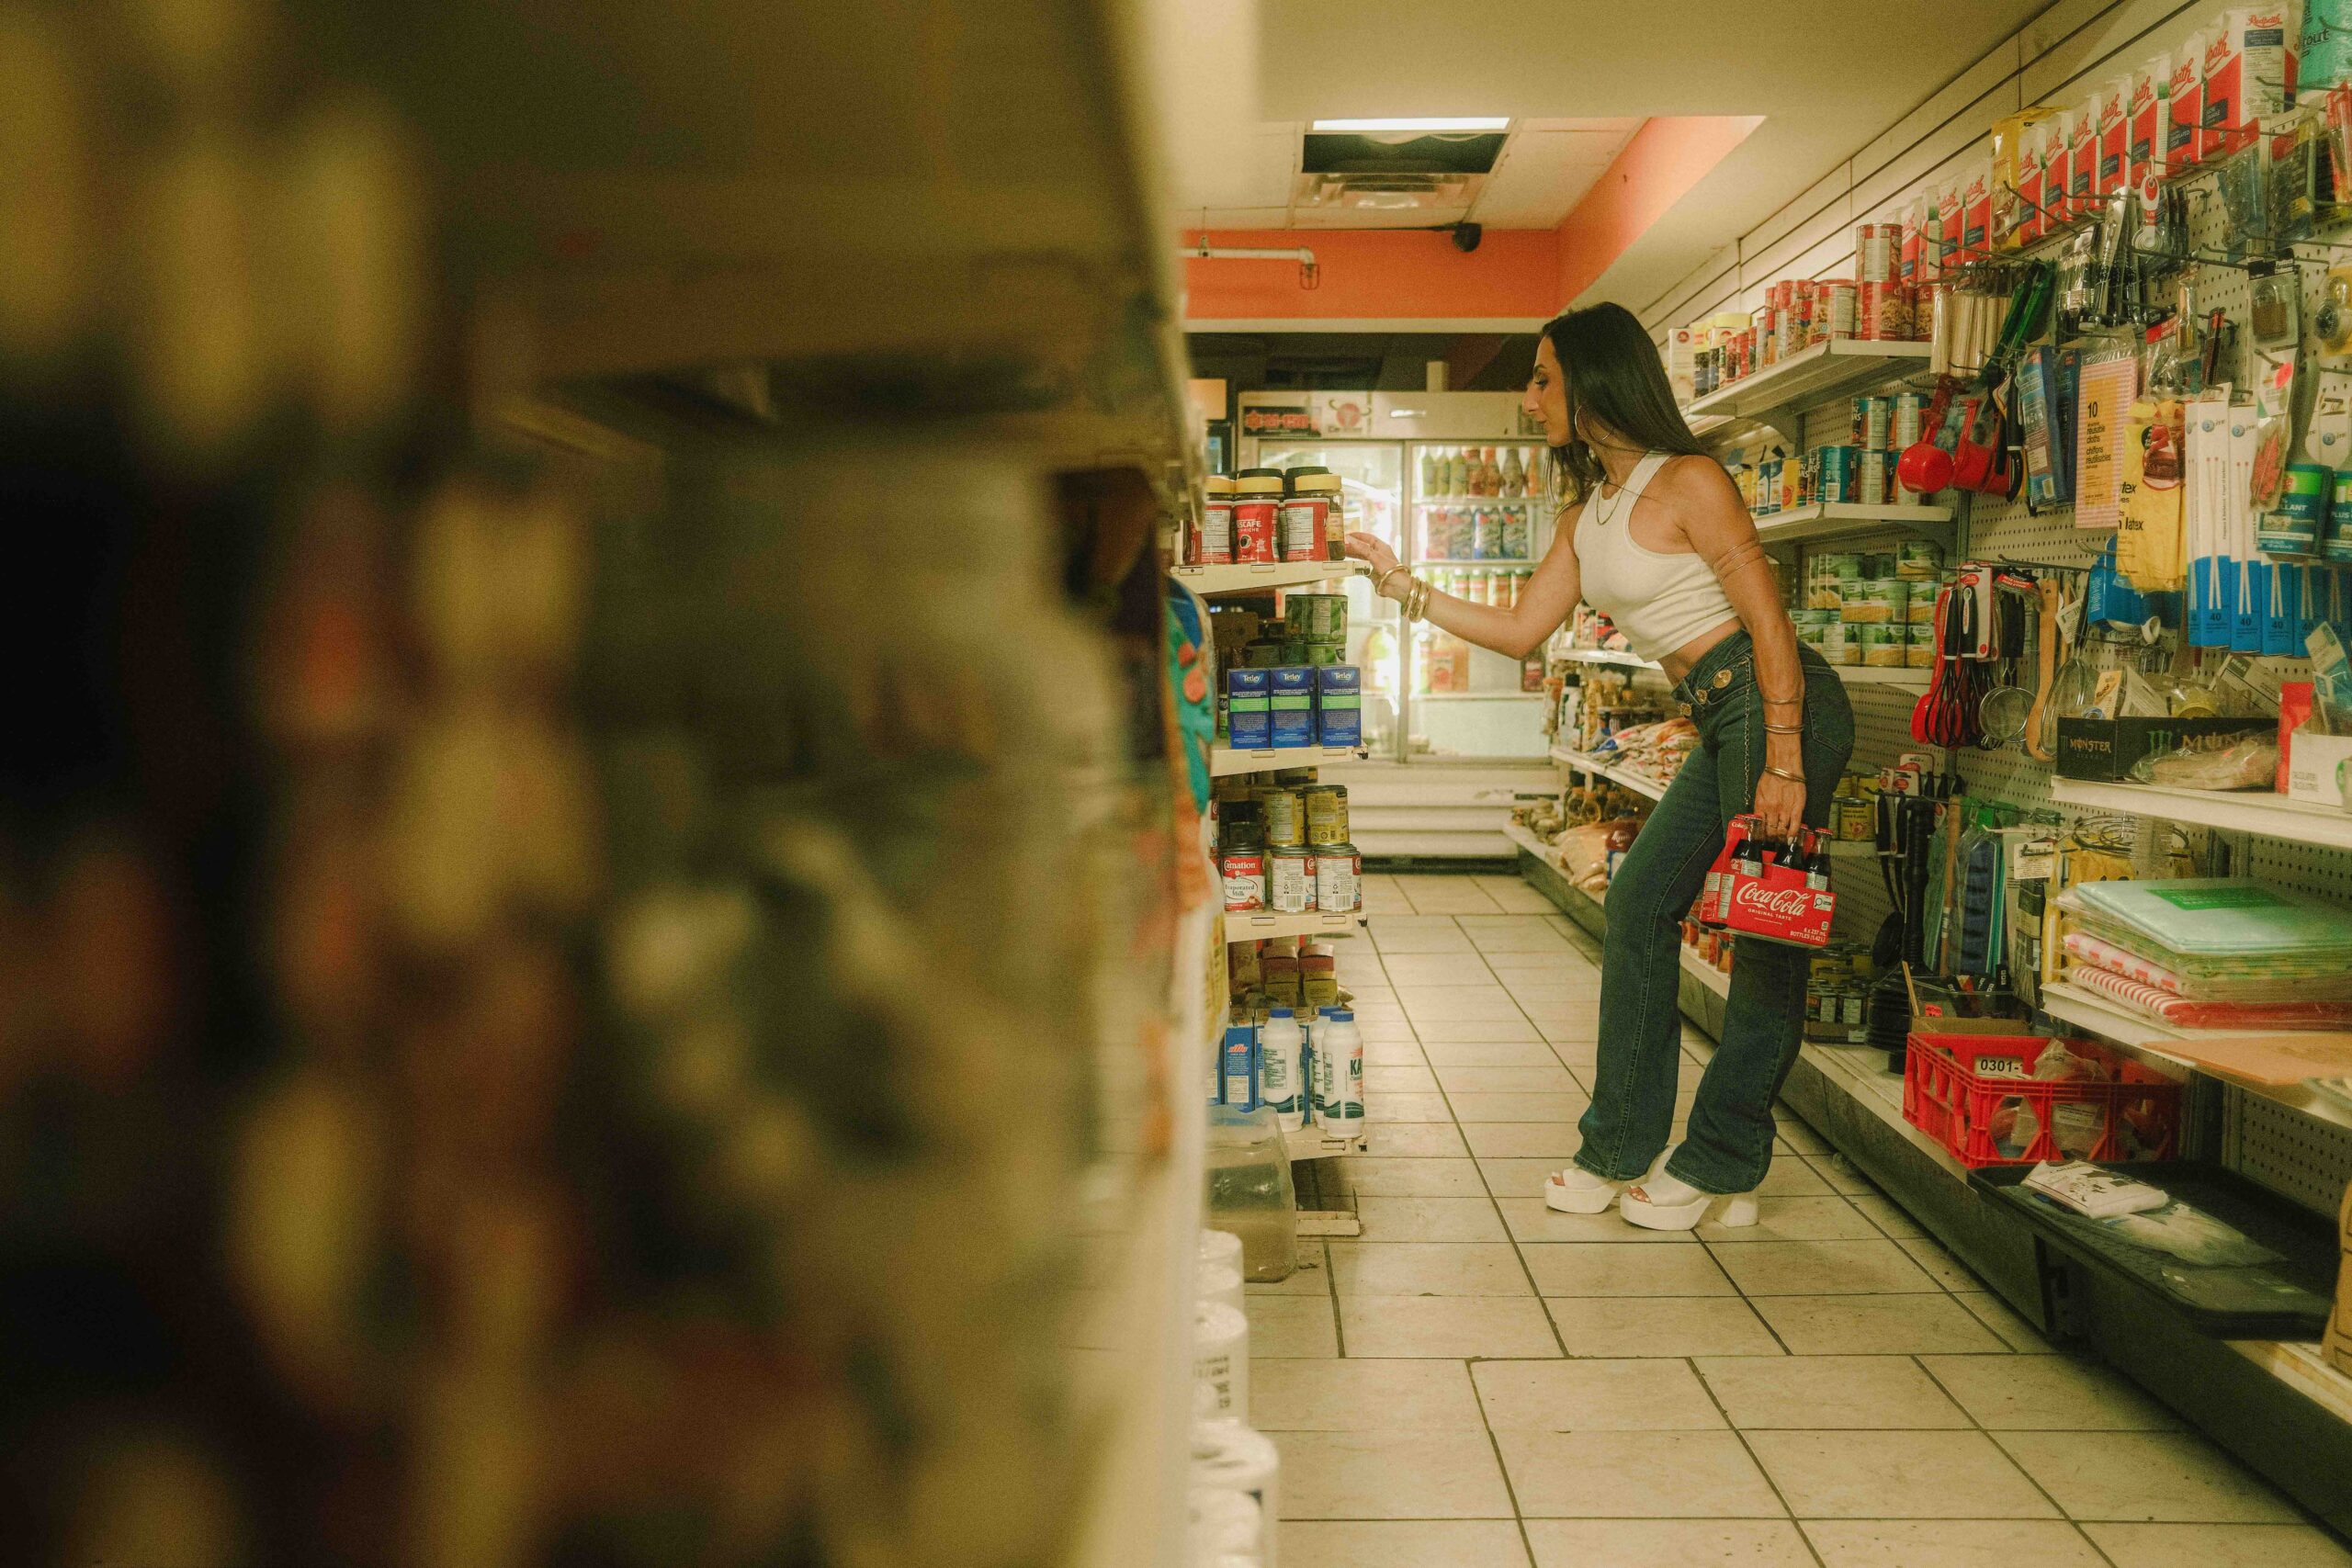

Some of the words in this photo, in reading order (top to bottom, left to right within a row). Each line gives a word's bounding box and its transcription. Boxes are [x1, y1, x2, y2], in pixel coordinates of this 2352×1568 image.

[2087, 401, 2098, 418] 10
[2121, 481, 2137, 494] tex
[2125, 516, 2144, 531] latex
[2210, 613, 2222, 621] 40
[2240, 618, 2251, 626] 40
[2271, 621, 2283, 629] 40
[1242, 674, 1261, 683] Tetley
[1283, 672, 1301, 682] Tetley
[1334, 671, 1352, 681] Tetley
[2070, 737, 2111, 753] MONSTER
[1224, 860, 1256, 871] Carnation
[1736, 881, 1812, 917] Coca-Cola
[1747, 908, 1774, 917] ORIGINAL
[1775, 912, 1792, 921] TASTE
[1790, 931, 1810, 940] BOTTLES
[1980, 1059, 2023, 1073] 0301-
